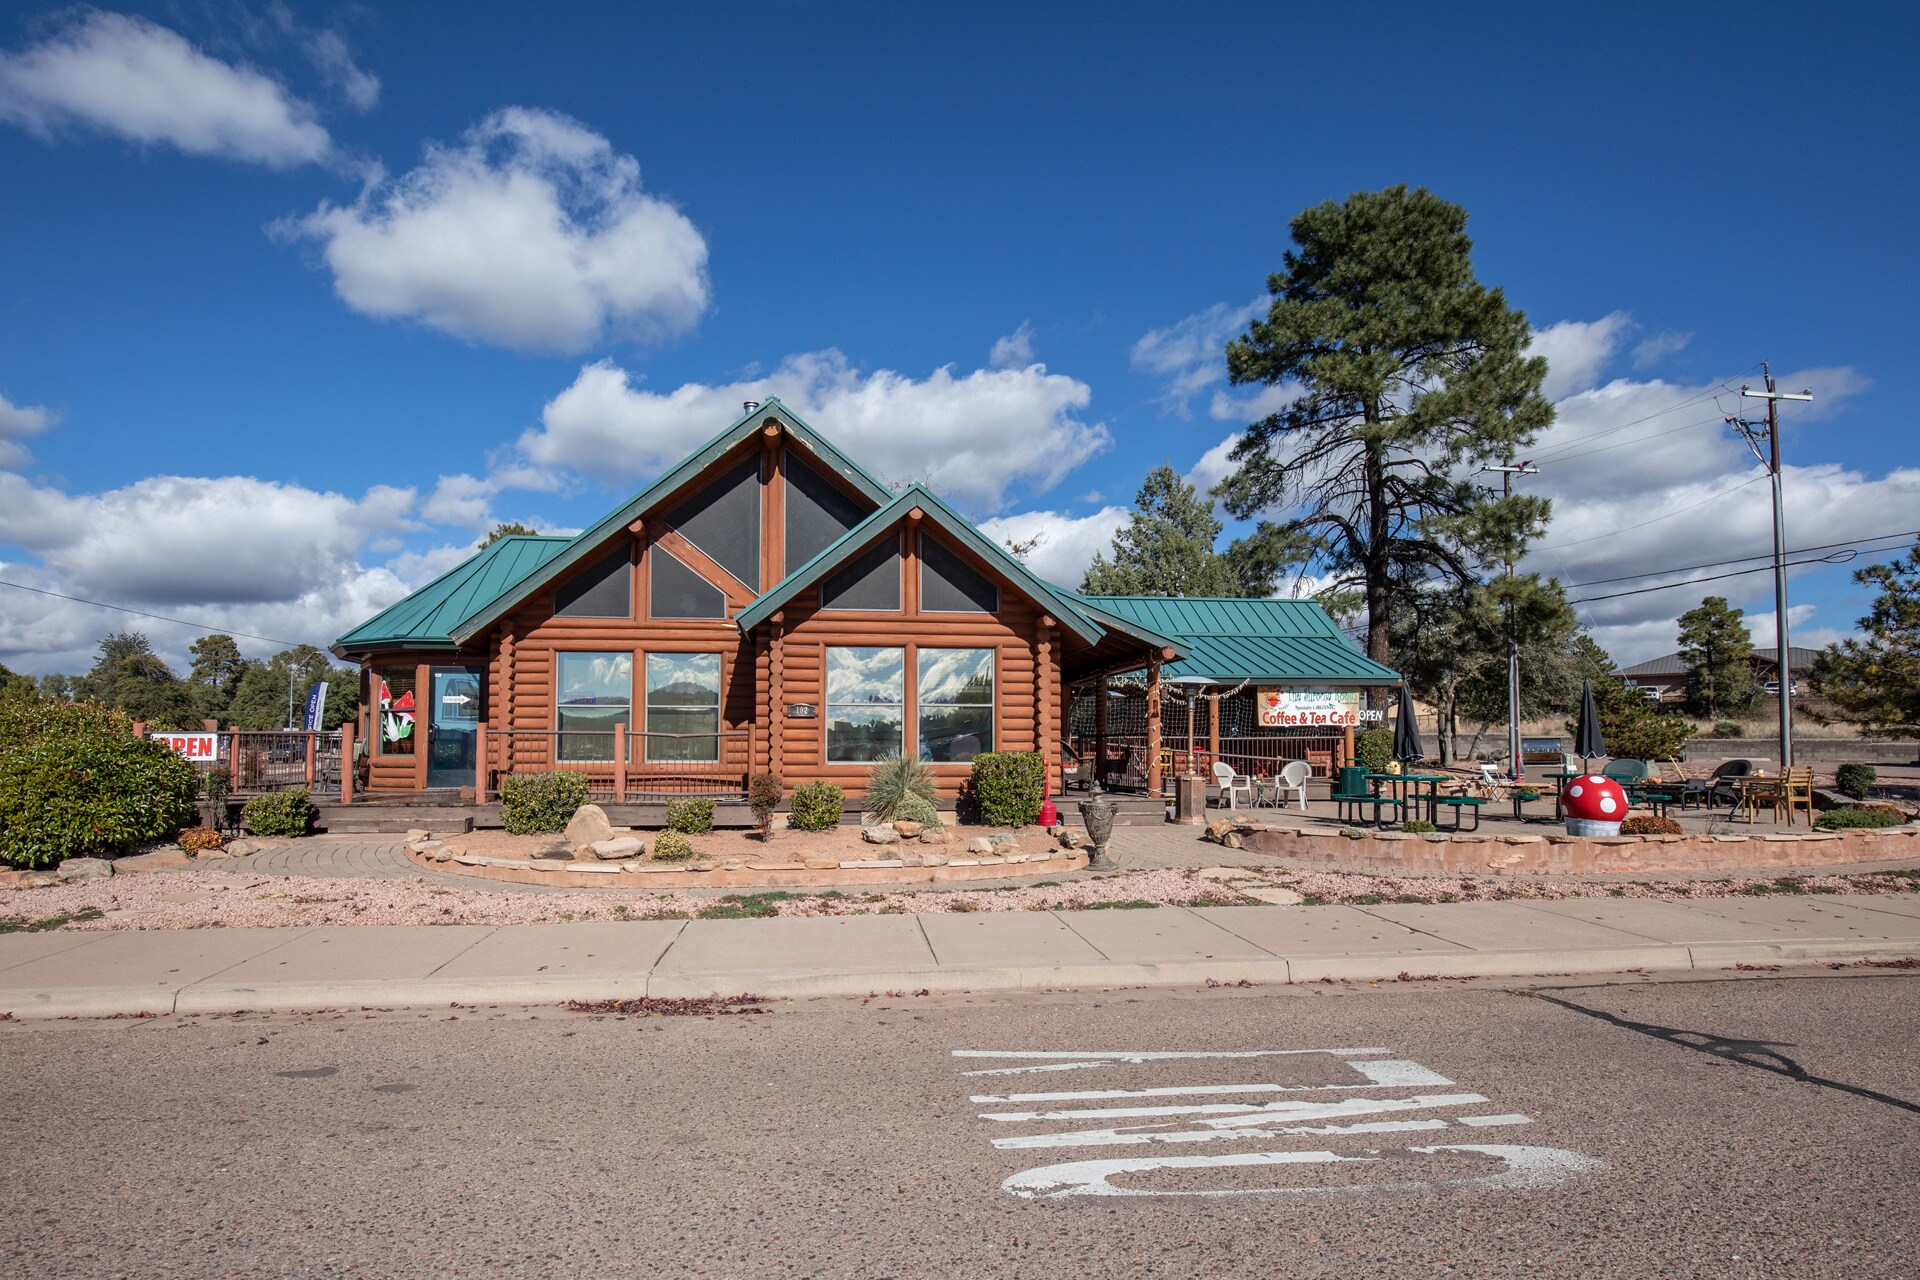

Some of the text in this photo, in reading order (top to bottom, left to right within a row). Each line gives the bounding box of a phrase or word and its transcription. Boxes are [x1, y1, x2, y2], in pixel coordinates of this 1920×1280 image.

[1288, 687, 1301, 702] The
[309, 694, 317, 713] OPEN
[796, 706, 808, 715] 102
[1262, 711, 1356, 725] Coffee & Tea Cafe
[1358, 709, 1383, 721] OPEN
